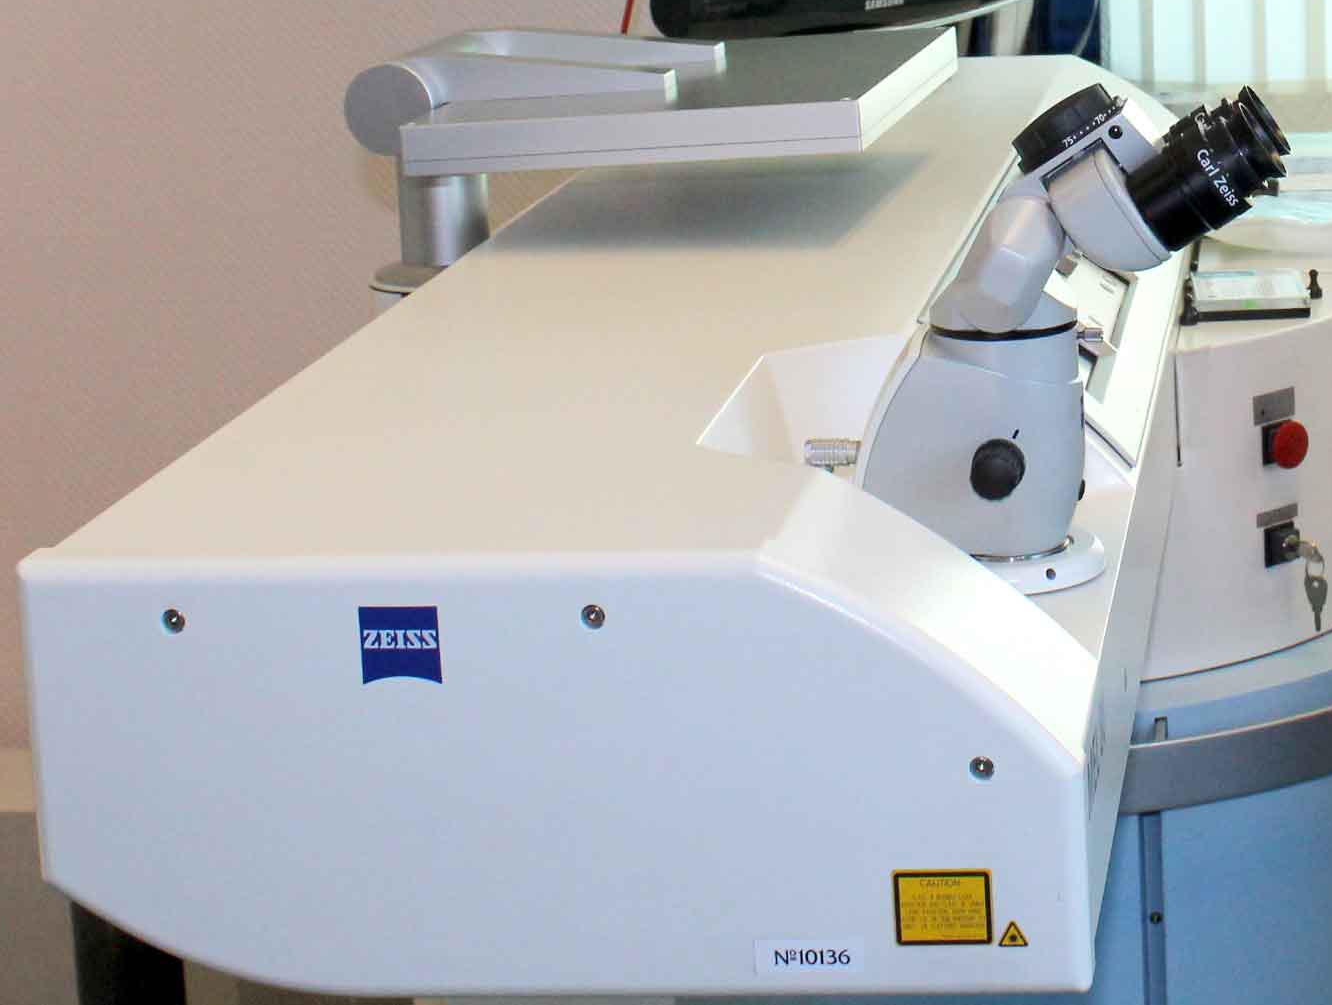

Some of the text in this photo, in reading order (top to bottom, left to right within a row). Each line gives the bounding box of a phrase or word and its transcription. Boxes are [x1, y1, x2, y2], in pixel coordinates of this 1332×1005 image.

[1094, 113, 1105, 125] 70
[1197, 149, 1220, 177] Carl
[1213, 176, 1239, 207] Zeiss
[363, 629, 437, 649] ZEISS
[919, 878, 961, 888] CAUTION
